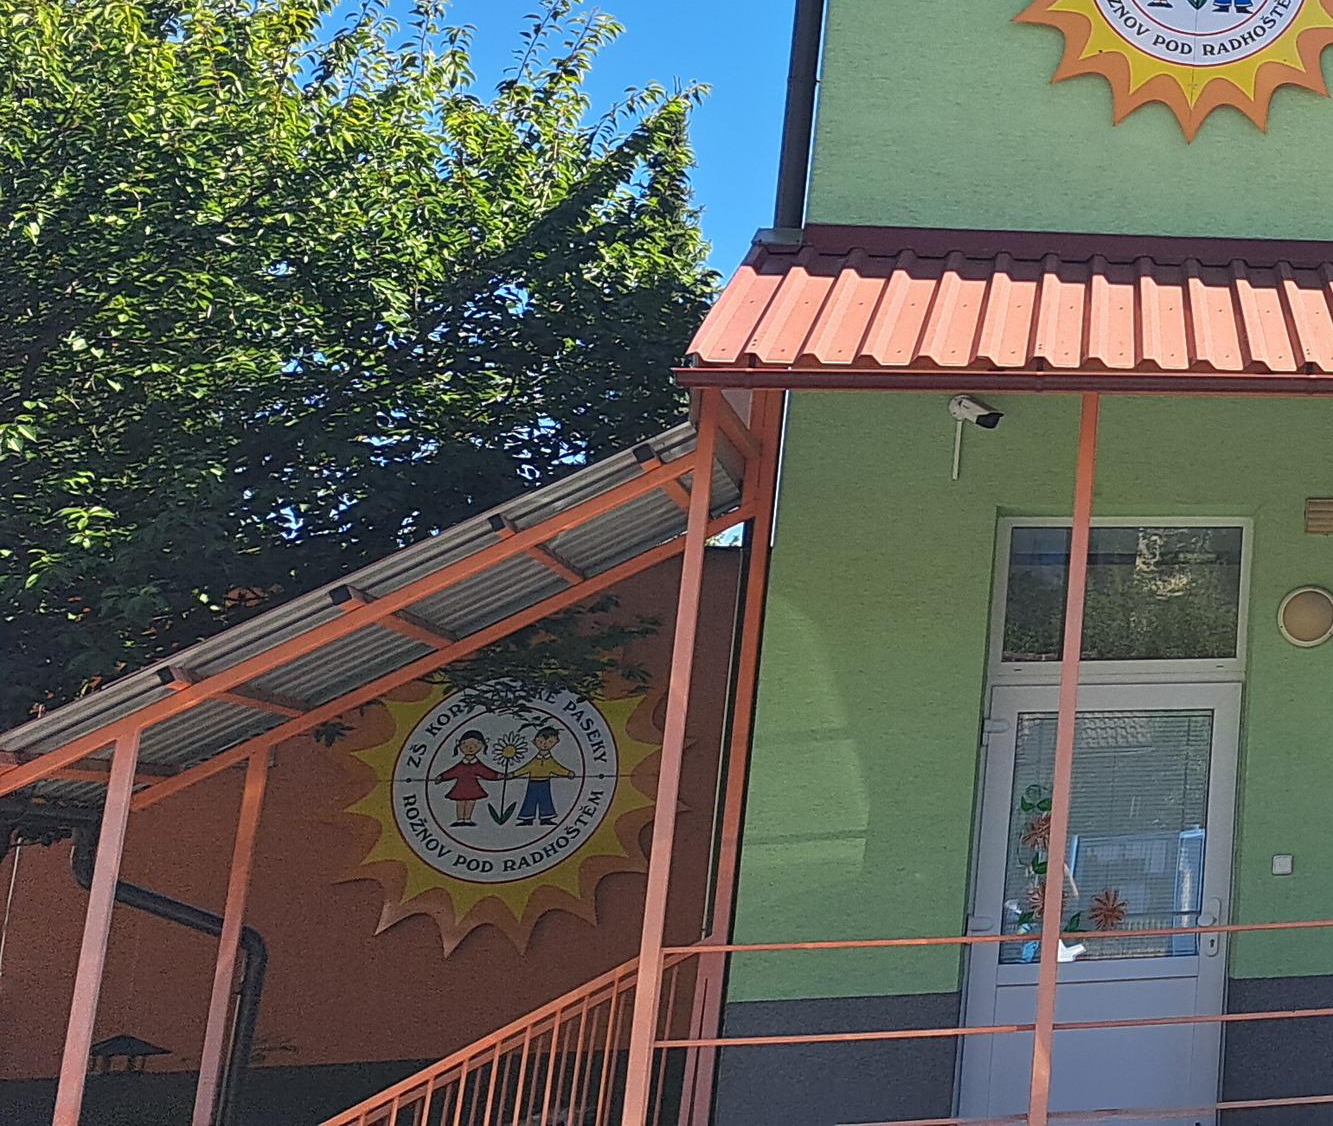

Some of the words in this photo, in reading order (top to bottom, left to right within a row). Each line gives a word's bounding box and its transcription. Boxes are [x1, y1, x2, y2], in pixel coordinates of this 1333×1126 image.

[1152, 34, 1193, 55] POD
[406, 742, 428, 769] ZŠ
[563, 699, 608, 763] PASEKY
[403, 794, 450, 858] ROŽNOV
[452, 854, 494, 873] POD
[502, 789, 605, 872] RADHOŠTĚM
